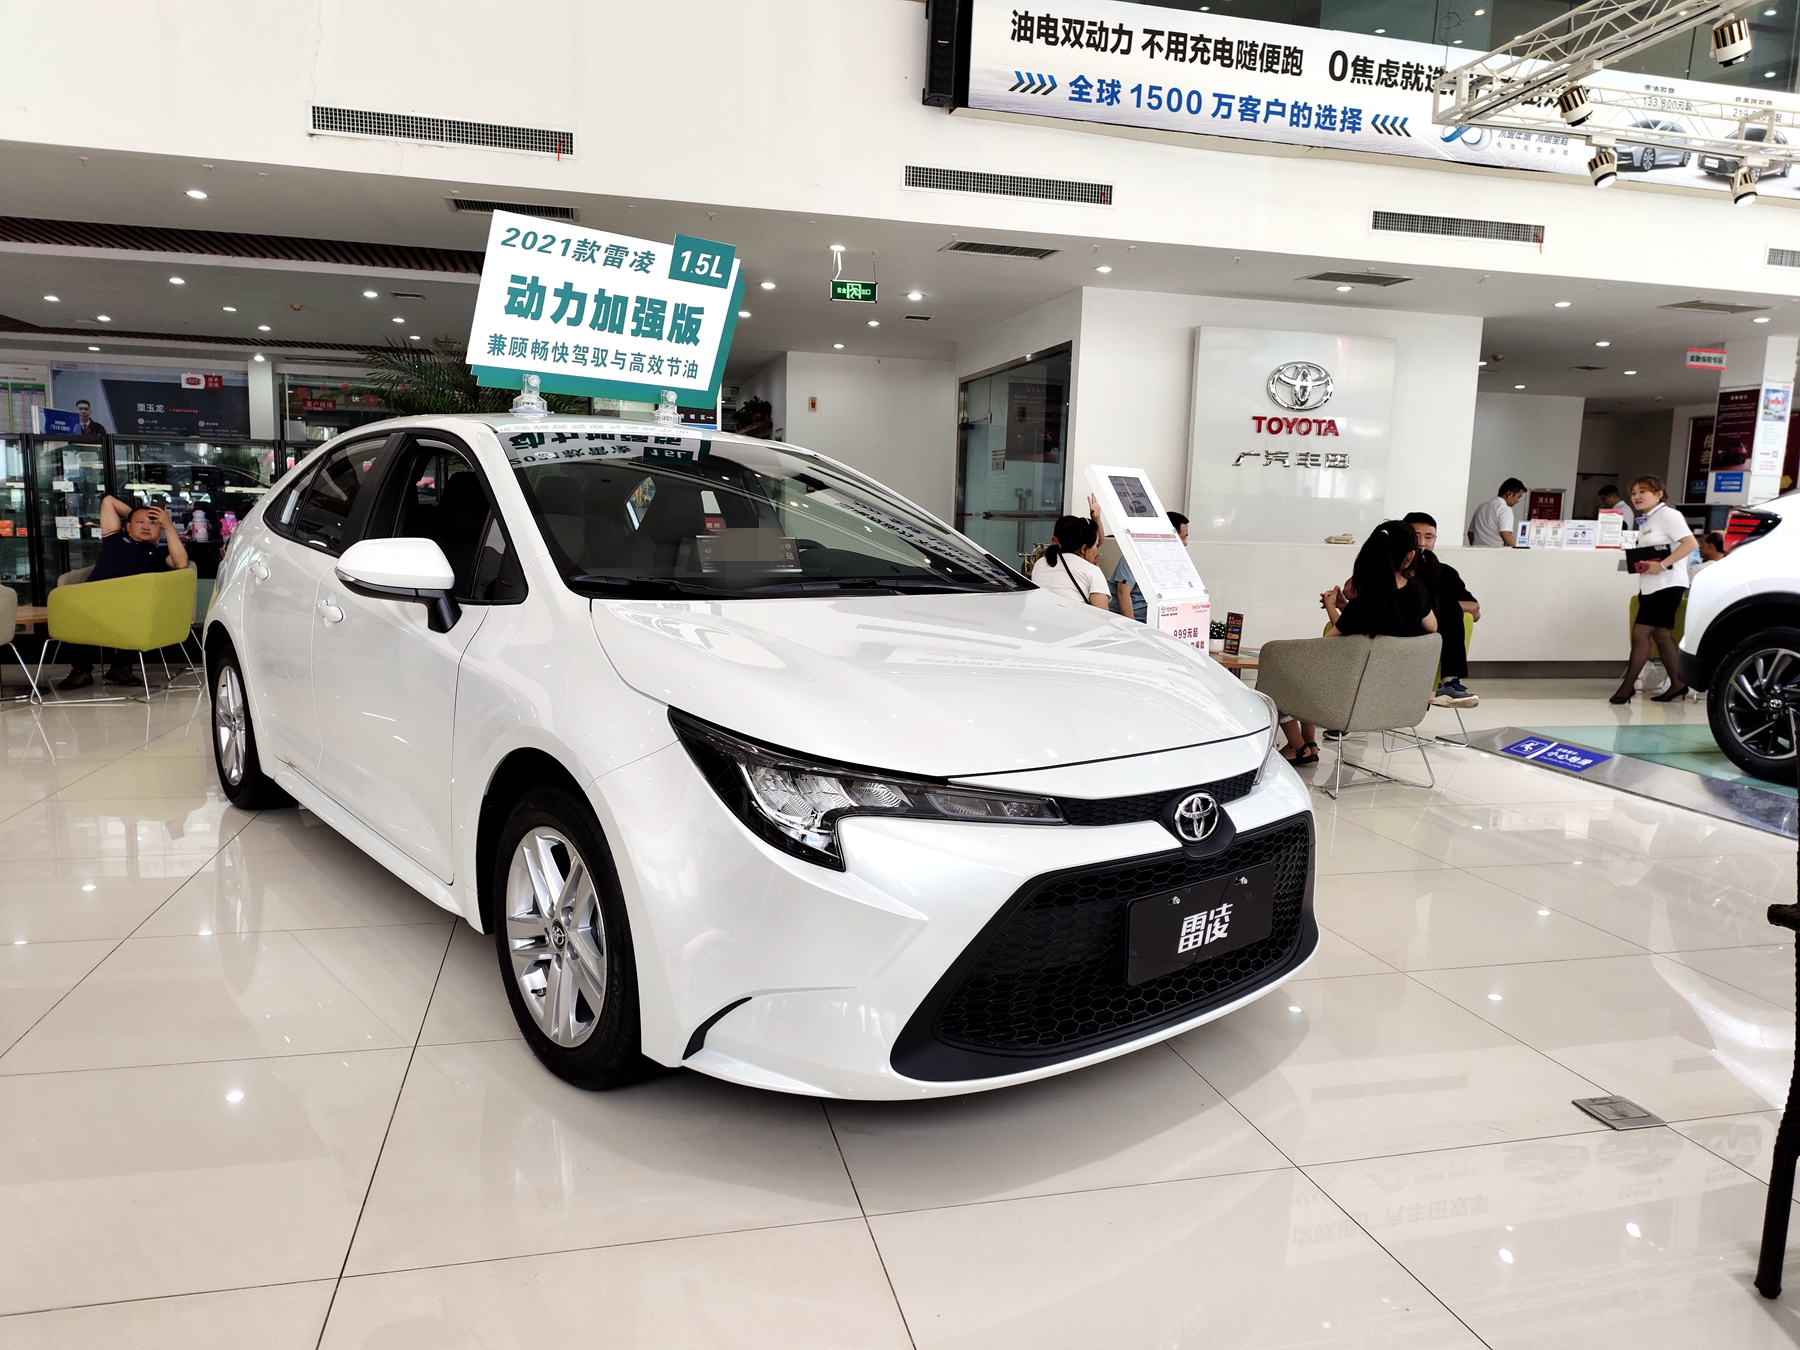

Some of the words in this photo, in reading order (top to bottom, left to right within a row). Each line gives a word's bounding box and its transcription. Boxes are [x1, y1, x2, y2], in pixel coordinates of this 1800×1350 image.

[1010, 10, 1134, 56] 油电双动力
[1140, 27, 1304, 77] 不用充电随便跑
[1068, 74, 1122, 106] 全球
[1130, 84, 1203, 115] 1500
[1211, 92, 1364, 134] 万客户的选择
[500, 227, 657, 275] 2021款雷凌
[679, 250, 724, 279] 1.5L
[504, 273, 705, 347] 动力加强版
[486, 332, 700, 380] 兼顾畅快驾驭与高效节油
[1252, 416, 1339, 437] TOYOTA
[1232, 449, 1351, 469] 广汽丰田
[1176, 902, 1234, 954] 雷凌
